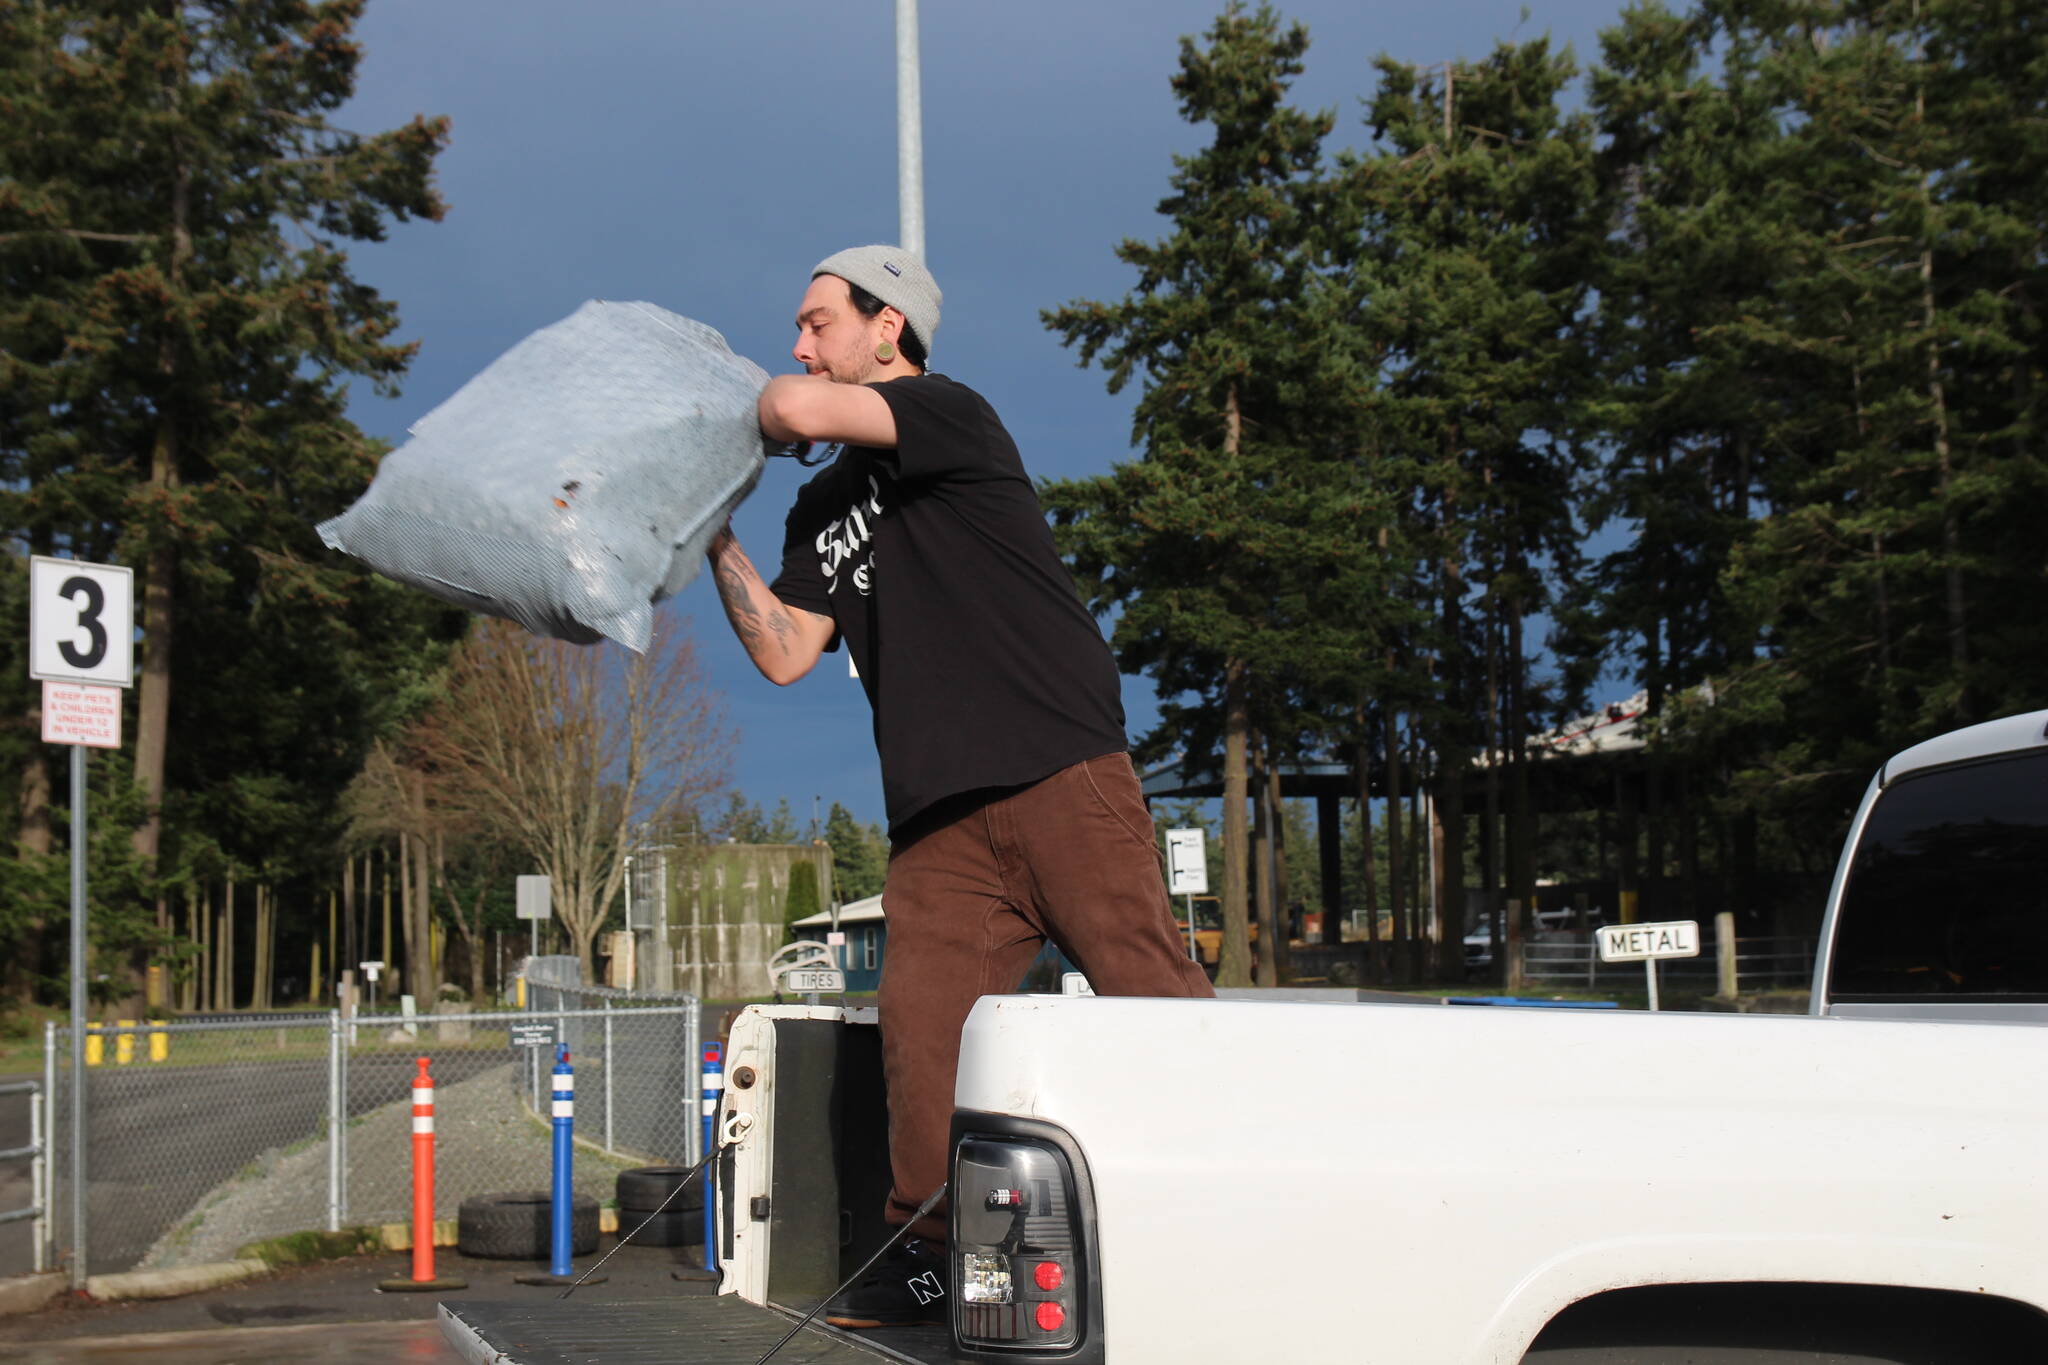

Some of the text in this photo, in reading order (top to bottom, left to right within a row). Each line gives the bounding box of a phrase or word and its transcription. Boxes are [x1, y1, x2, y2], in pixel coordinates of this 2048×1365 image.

[57, 576, 107, 669] 3
[52, 691, 113, 703] KEEP PETS
[60, 703, 114, 714] CHILDREN
[56, 714, 93, 724] UNDER
[66, 726, 113, 737] VEHICLE
[1610, 929, 1688, 953] METAL
[800, 973, 834, 987] TIRES
